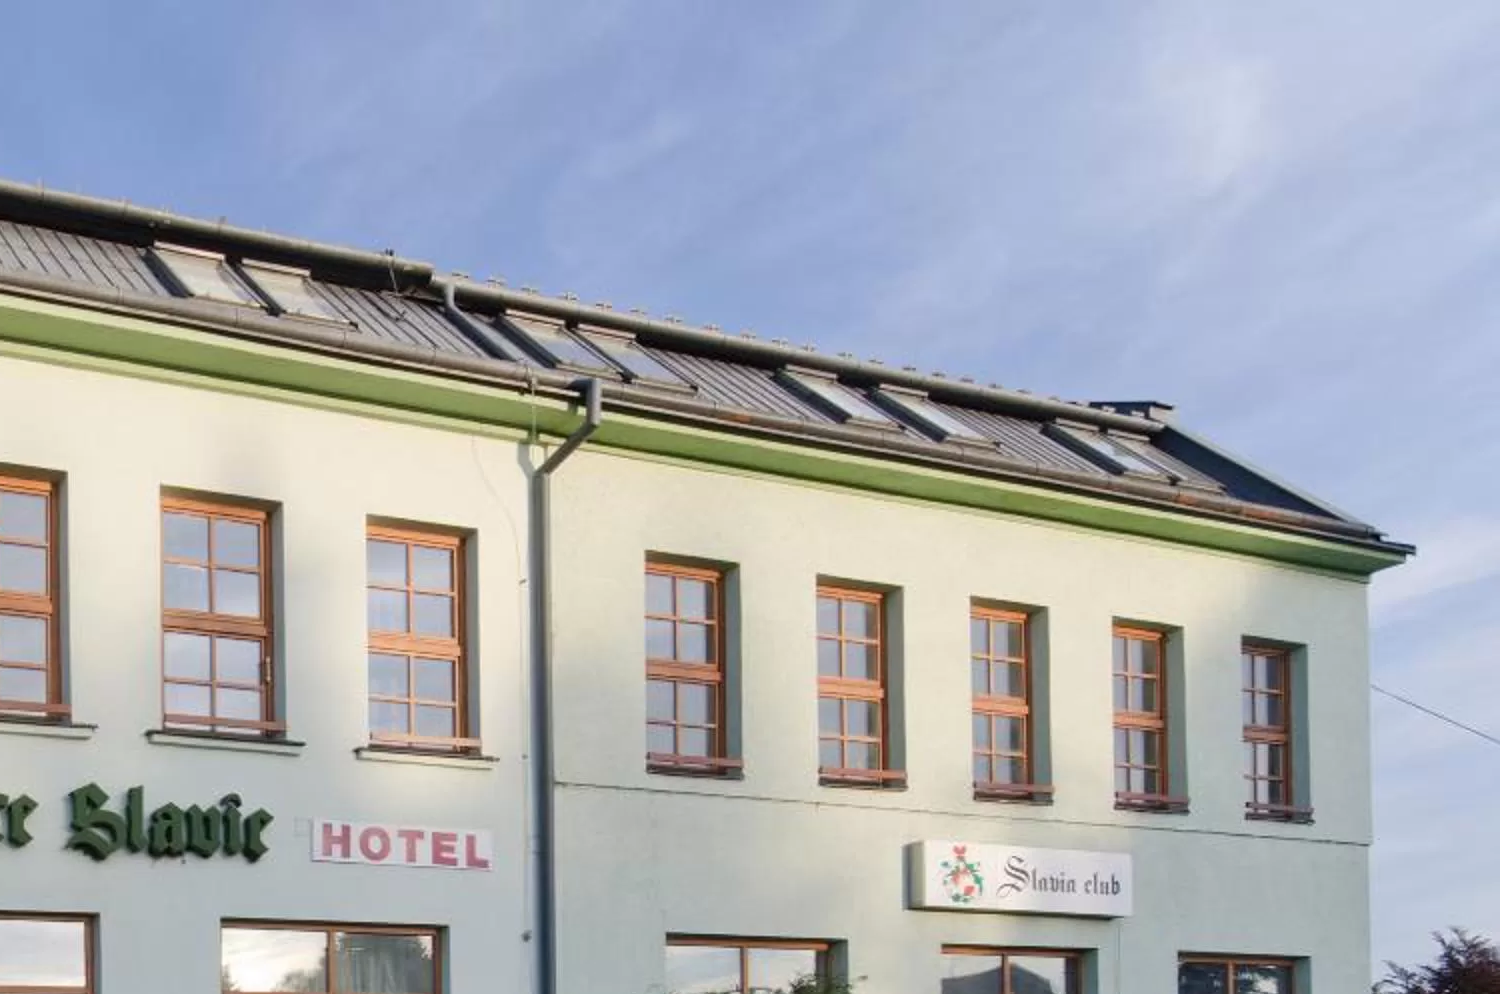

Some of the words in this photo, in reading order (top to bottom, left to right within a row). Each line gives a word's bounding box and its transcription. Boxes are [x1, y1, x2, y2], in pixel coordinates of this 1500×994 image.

[321, 822, 490, 869] HOTEL
[995, 854, 1077, 899] Slavia
[1083, 871, 1121, 896] club
